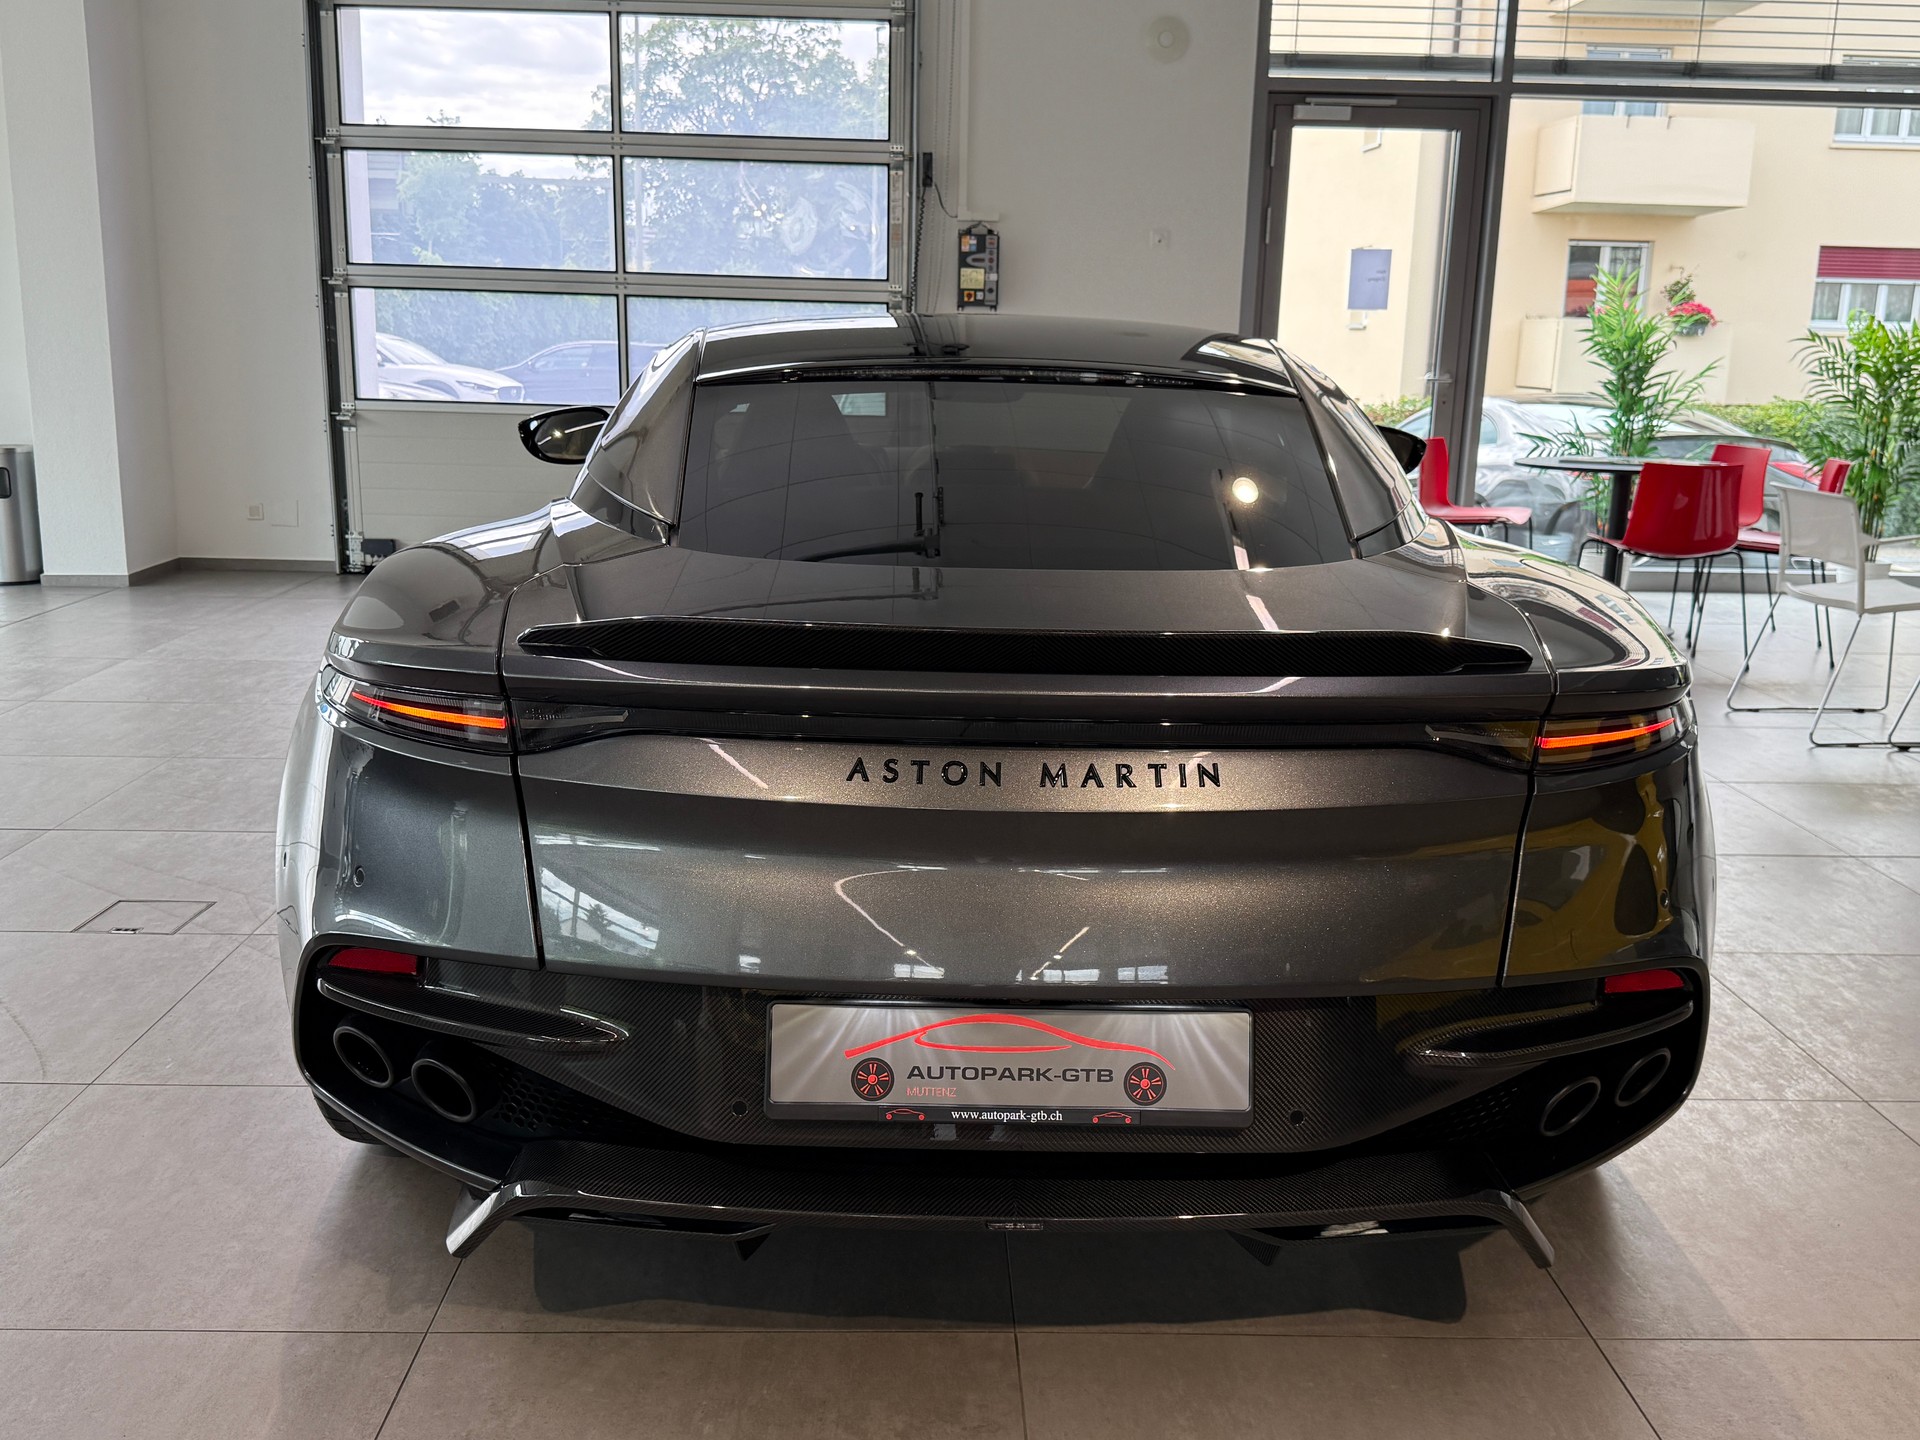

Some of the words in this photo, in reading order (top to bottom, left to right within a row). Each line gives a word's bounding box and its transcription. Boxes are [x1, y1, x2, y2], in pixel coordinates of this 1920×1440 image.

[846, 756, 1001, 787] ASTON
[1039, 762, 1221, 788] MARTIN
[906, 1065, 1114, 1083] AUTOPARK-GTB
[906, 1086, 957, 1098] MUTTENZ
[951, 1109, 1063, 1123] www.autopark-gtb.ch
